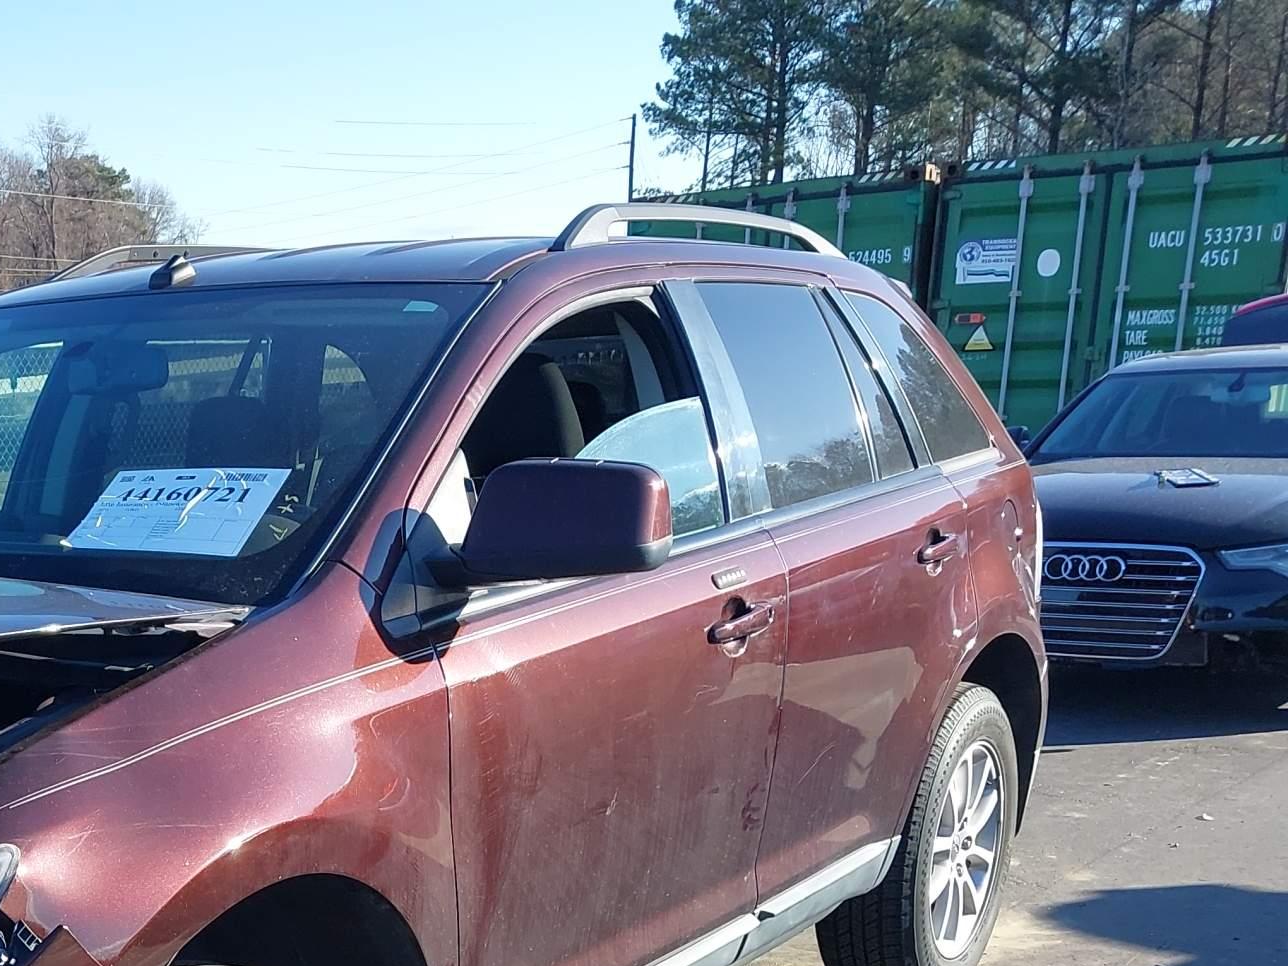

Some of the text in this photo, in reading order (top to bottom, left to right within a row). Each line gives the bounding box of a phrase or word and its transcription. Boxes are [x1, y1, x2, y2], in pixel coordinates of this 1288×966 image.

[1149, 223, 1284, 248] UACU 533731 0
[903, 247, 911, 264] 9
[1200, 249, 1239, 267] 45G1
[1124, 330, 1148, 346] TARE
[116, 486, 251, 503] 44160721
